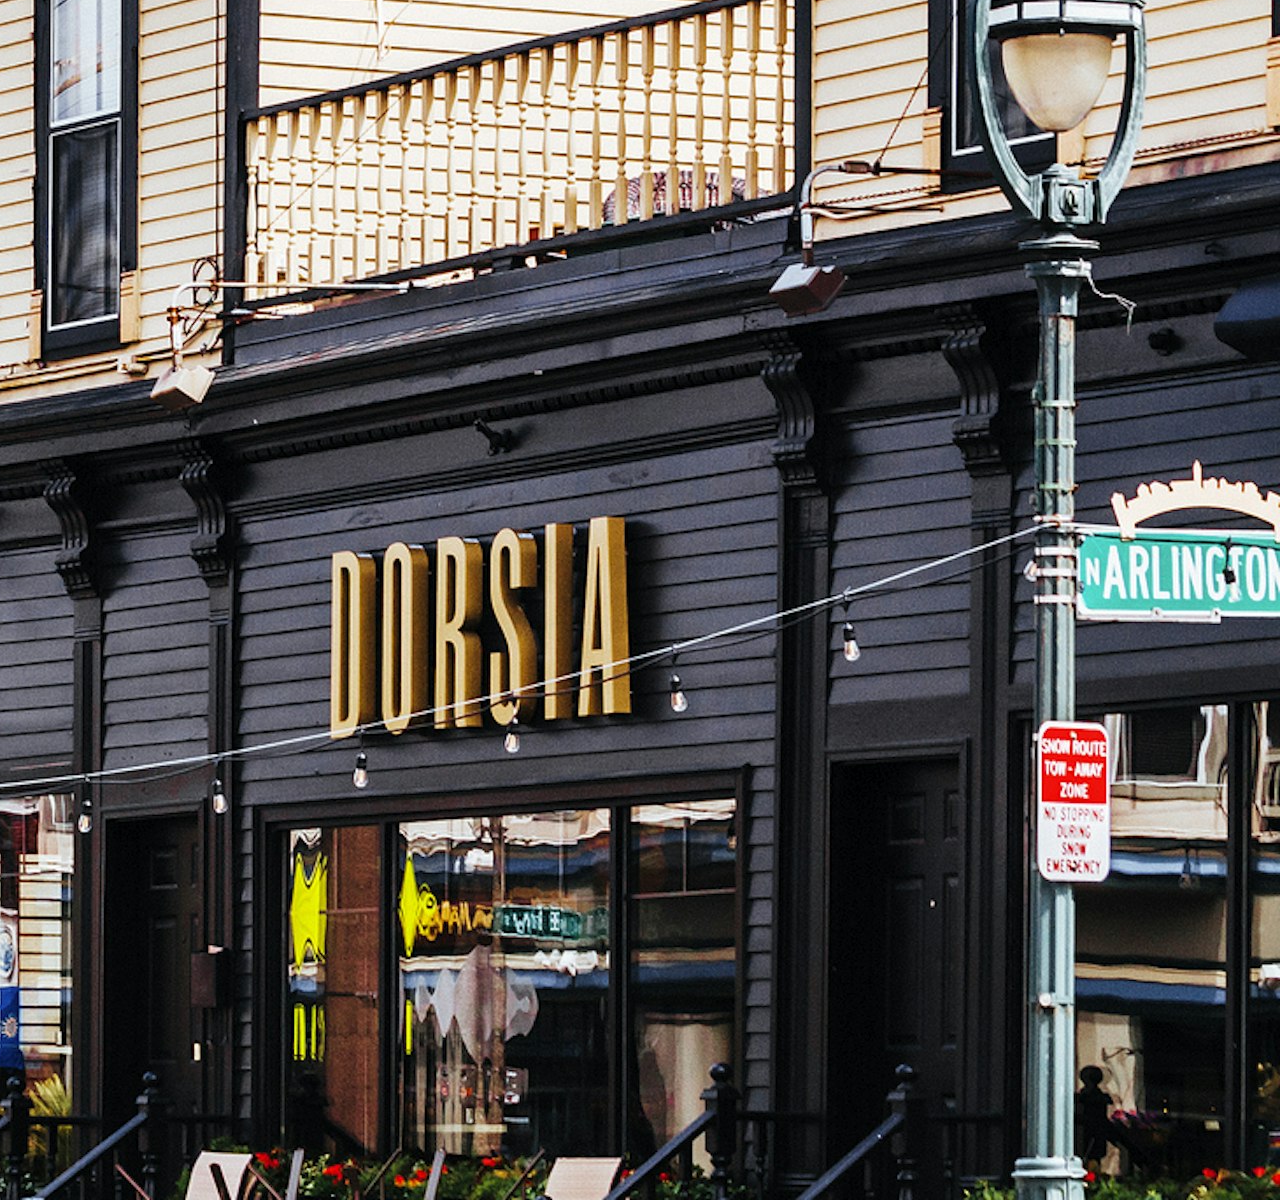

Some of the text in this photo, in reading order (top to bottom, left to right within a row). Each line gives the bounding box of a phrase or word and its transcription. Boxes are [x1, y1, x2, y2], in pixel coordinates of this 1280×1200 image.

[1085, 557, 1101, 586] N
[330, 516, 632, 740] DORSIA
[1041, 738, 1107, 757] SNOW ROUTE
[1059, 782, 1089, 799] ZONE
[1043, 806, 1105, 822] NO STOPPING
[1056, 824, 1092, 839] DURING
[1062, 842, 1087, 857] SNOW
